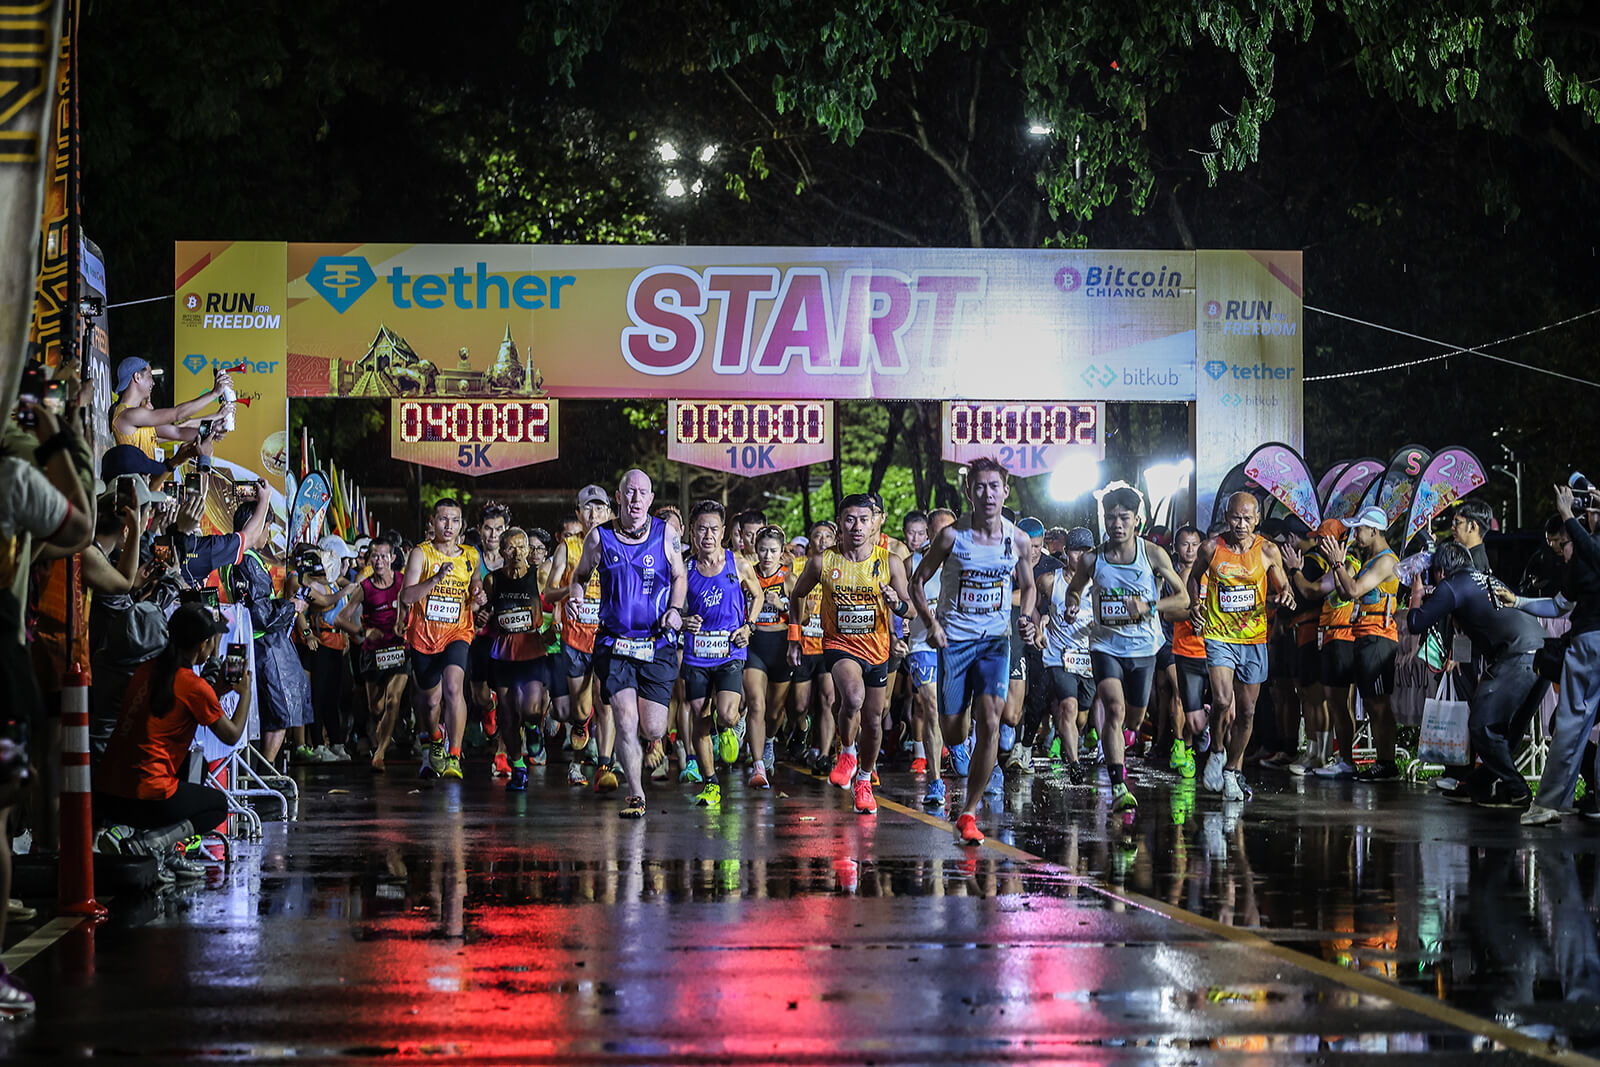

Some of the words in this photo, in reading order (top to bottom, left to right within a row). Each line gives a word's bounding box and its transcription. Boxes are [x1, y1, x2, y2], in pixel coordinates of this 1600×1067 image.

[387, 262, 577, 310] tether
[1086, 265, 1183, 287] Bitcoin
[205, 293, 256, 313] RUN
[254, 305, 271, 313] FOR
[1086, 288, 1146, 298] CHIANG
[1151, 288, 1181, 298] MAI
[203, 314, 281, 329] FREEDOM
[621, 264, 988, 376] START
[1225, 301, 1273, 320] RUN
[1223, 322, 1297, 336] FREEDOM
[1123, 368, 1179, 386] bitkub
[1231, 363, 1296, 380] tether
[1245, 395, 1279, 407] bitkub
[400, 402, 550, 443] 04:00:02
[677, 403, 825, 444] 00:00:00
[951, 404, 1097, 445] 00:00:02
[457, 444, 493, 468] 5K
[726, 445, 776, 470] 10K
[999, 446, 1049, 469] 21K
[1405, 452, 1422, 476] S
